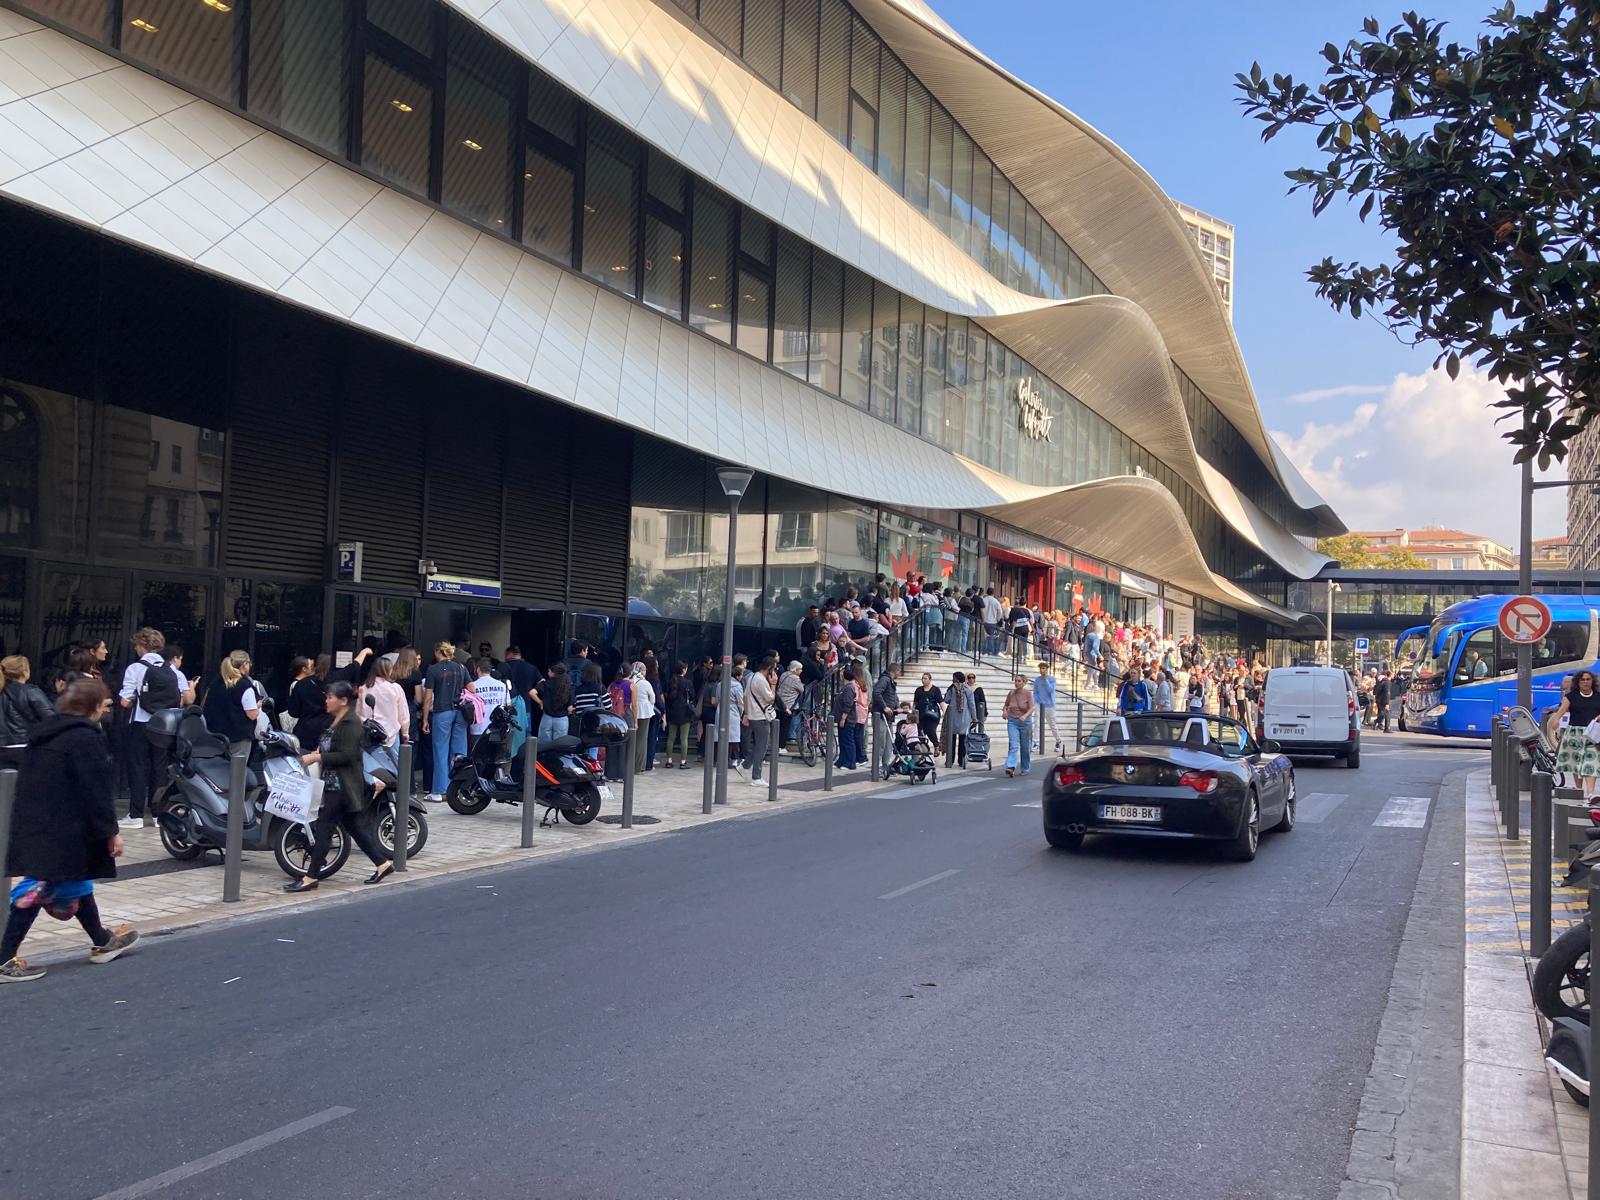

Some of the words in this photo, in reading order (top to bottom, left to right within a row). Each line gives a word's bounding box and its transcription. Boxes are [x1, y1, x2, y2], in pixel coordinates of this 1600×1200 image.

[341, 551, 351, 567] P
[1359, 640, 1366, 648] P
[1105, 806, 1154, 819] FH-088-BK
